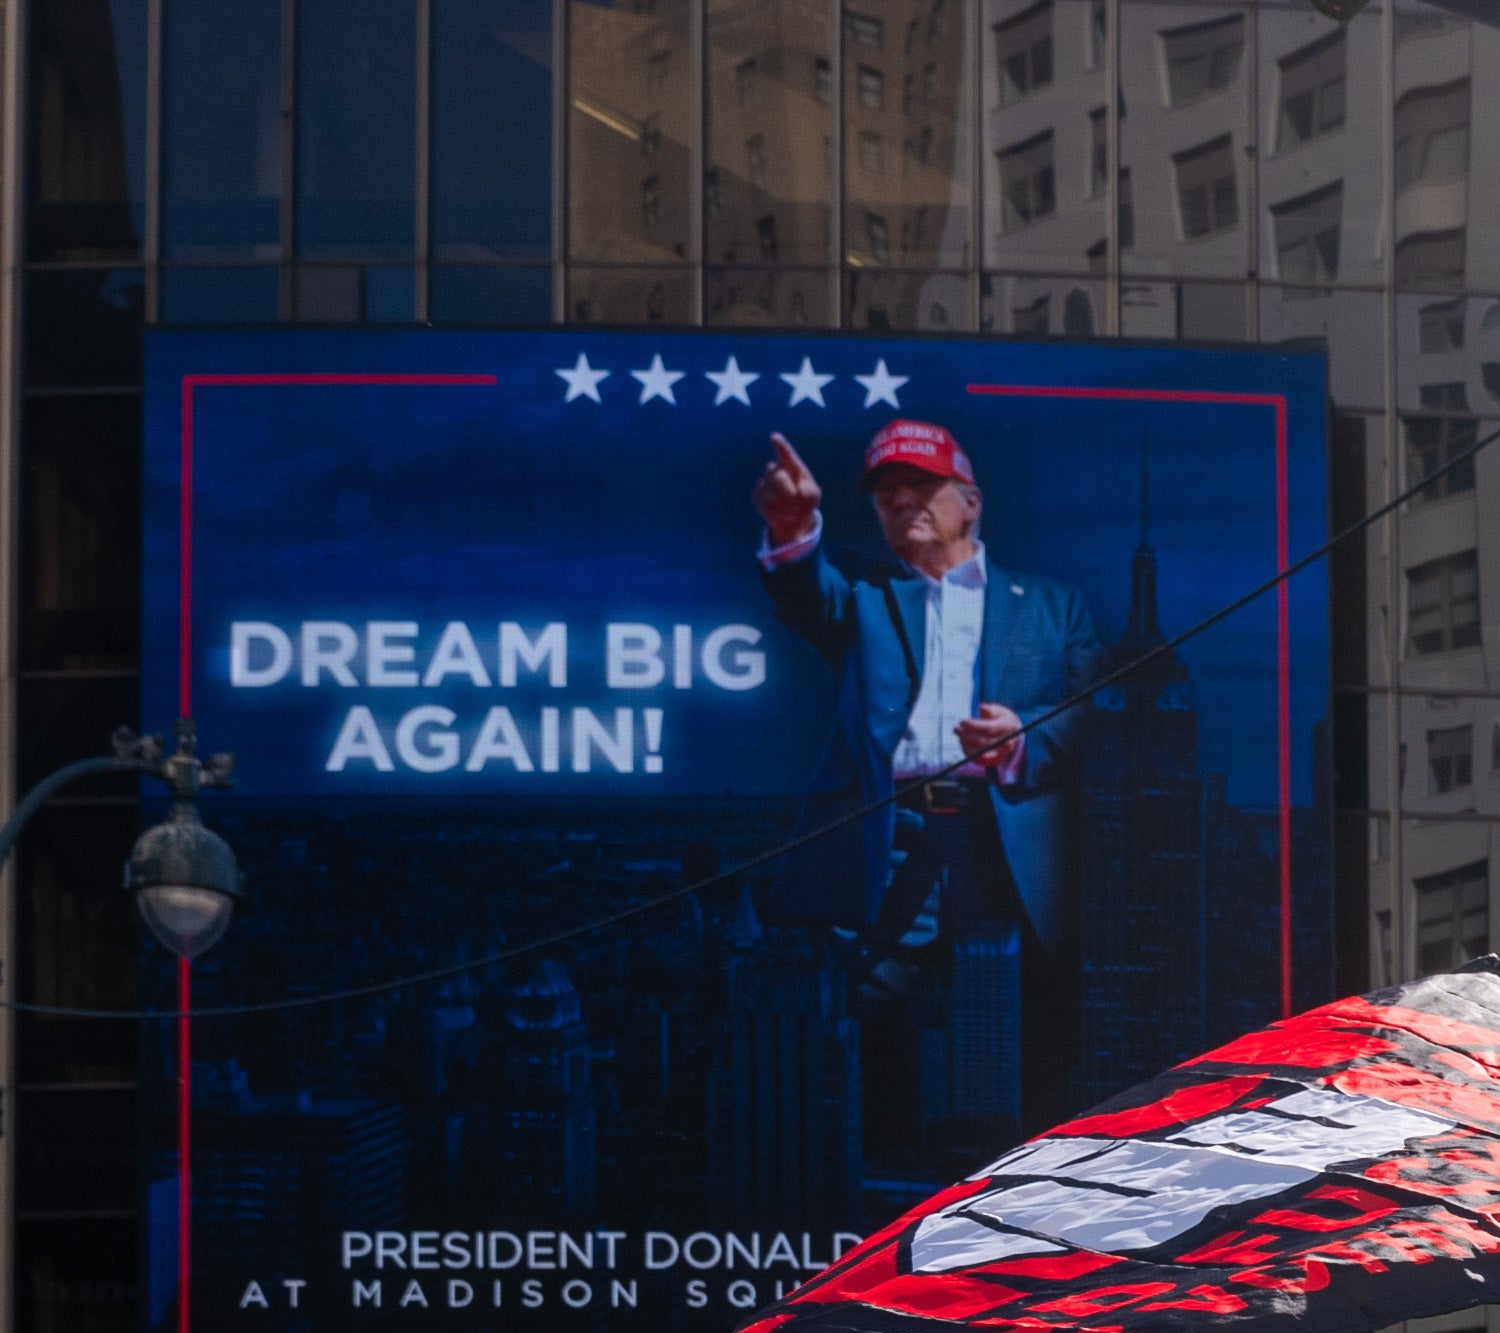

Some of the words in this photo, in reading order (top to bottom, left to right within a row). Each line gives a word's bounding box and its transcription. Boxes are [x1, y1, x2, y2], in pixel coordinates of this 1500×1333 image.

[229, 621, 569, 690] DREAM
[605, 624, 766, 691] BIG
[325, 706, 664, 775] AGAIN!
[342, 1231, 628, 1271] PRESIDENT
[240, 1279, 304, 1309] AT
[353, 1279, 640, 1309] MADISON
